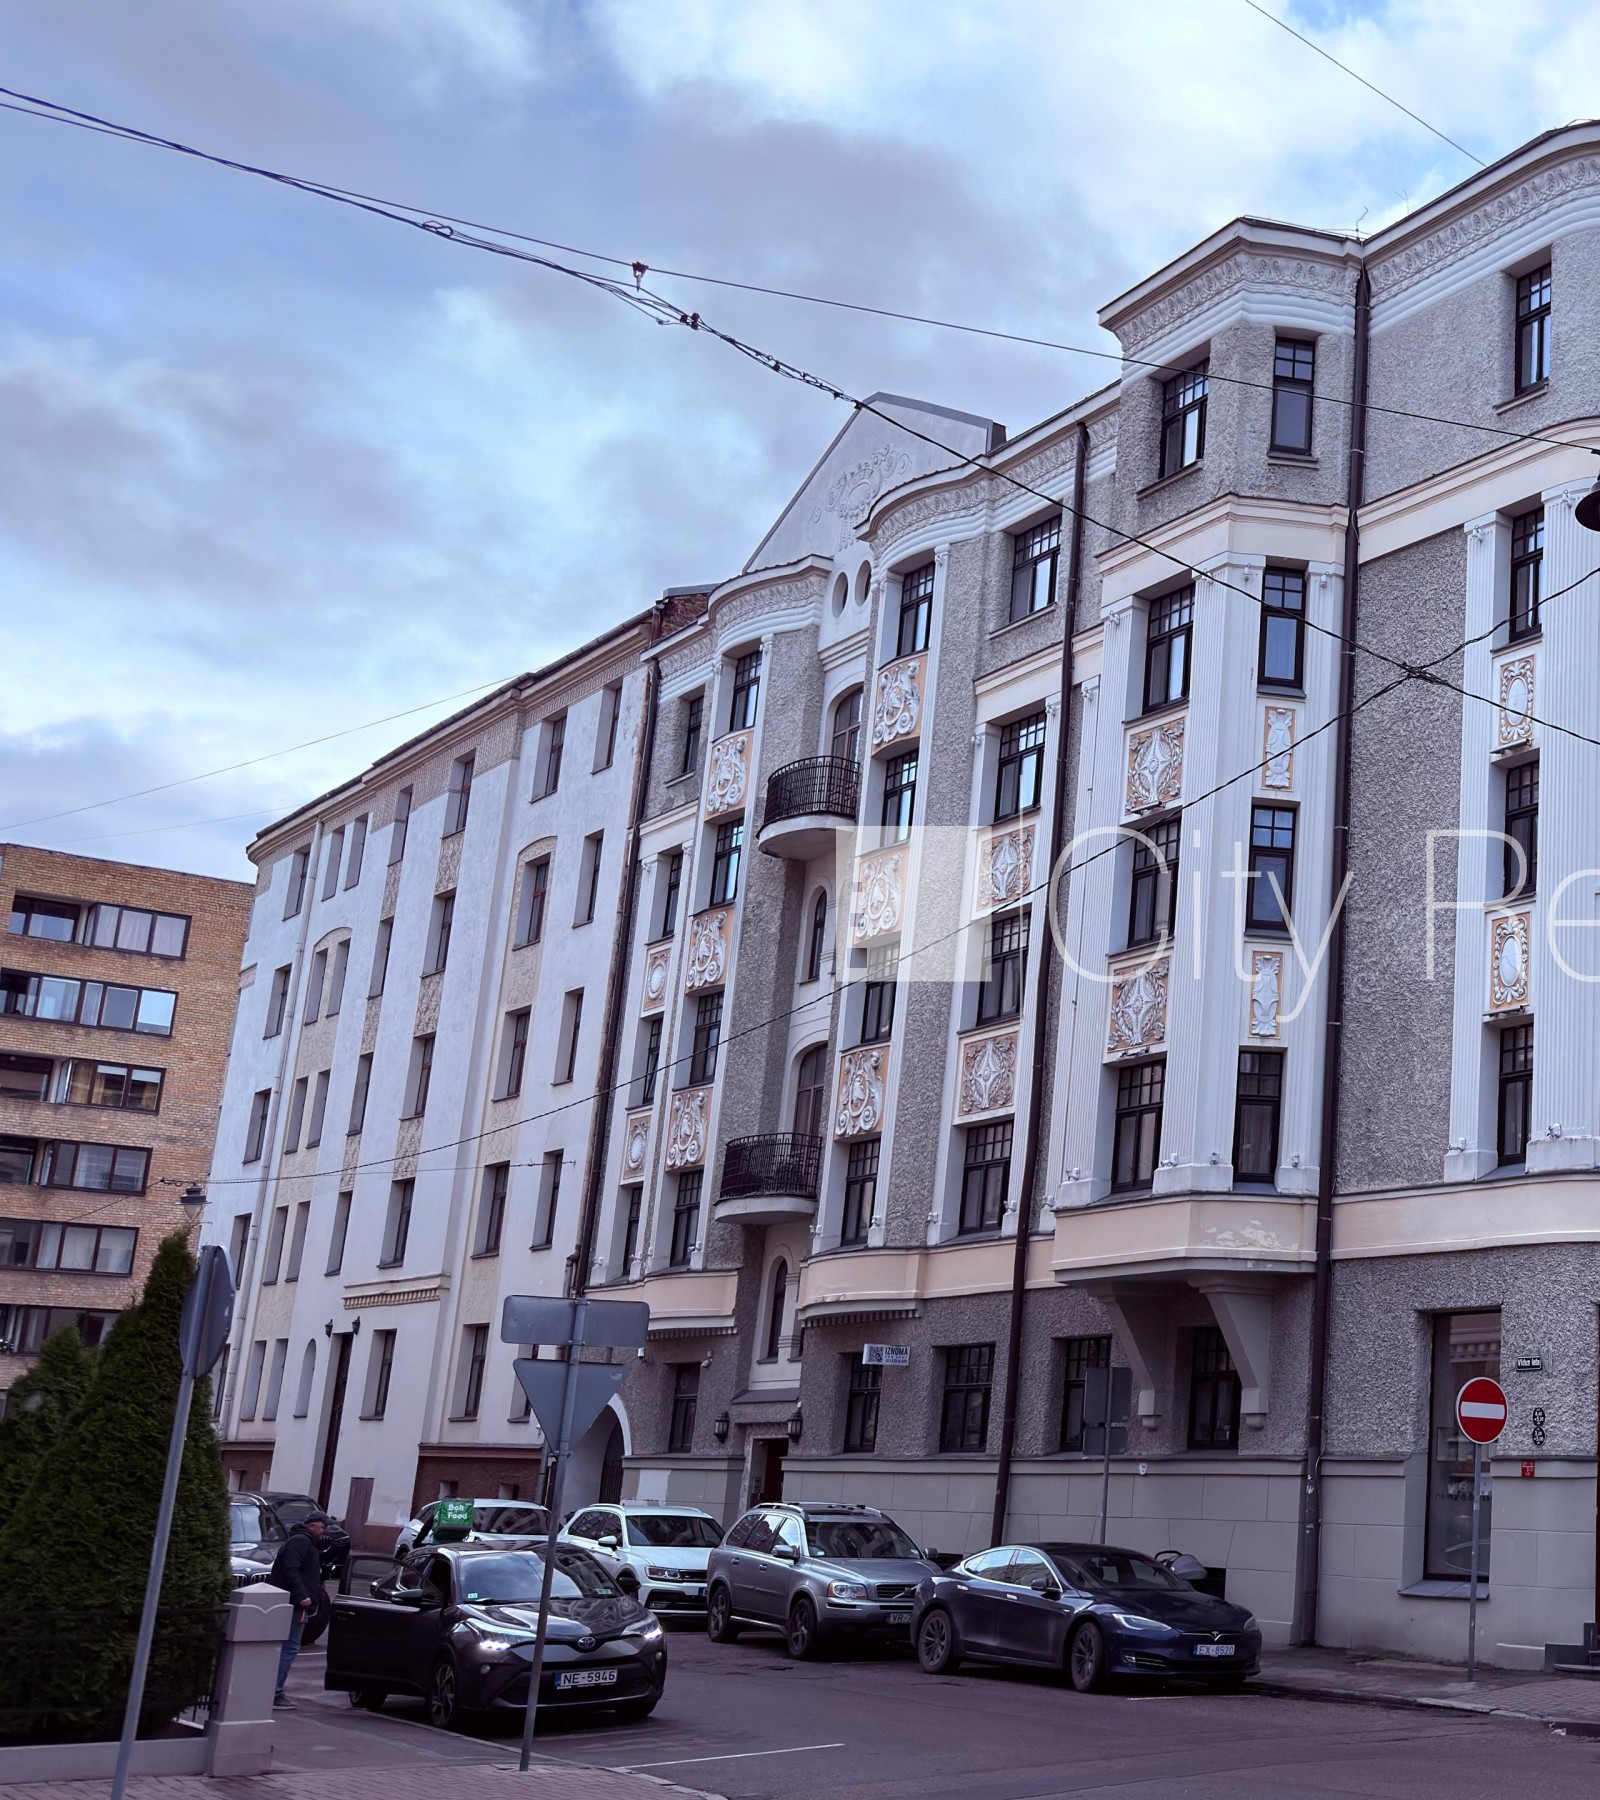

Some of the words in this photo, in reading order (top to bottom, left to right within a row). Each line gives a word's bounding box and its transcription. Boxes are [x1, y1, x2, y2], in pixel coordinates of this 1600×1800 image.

[448, 1503, 465, 1511] Bolt
[447, 1511, 468, 1519] Food
[563, 1670, 616, 1685] NE-5946
